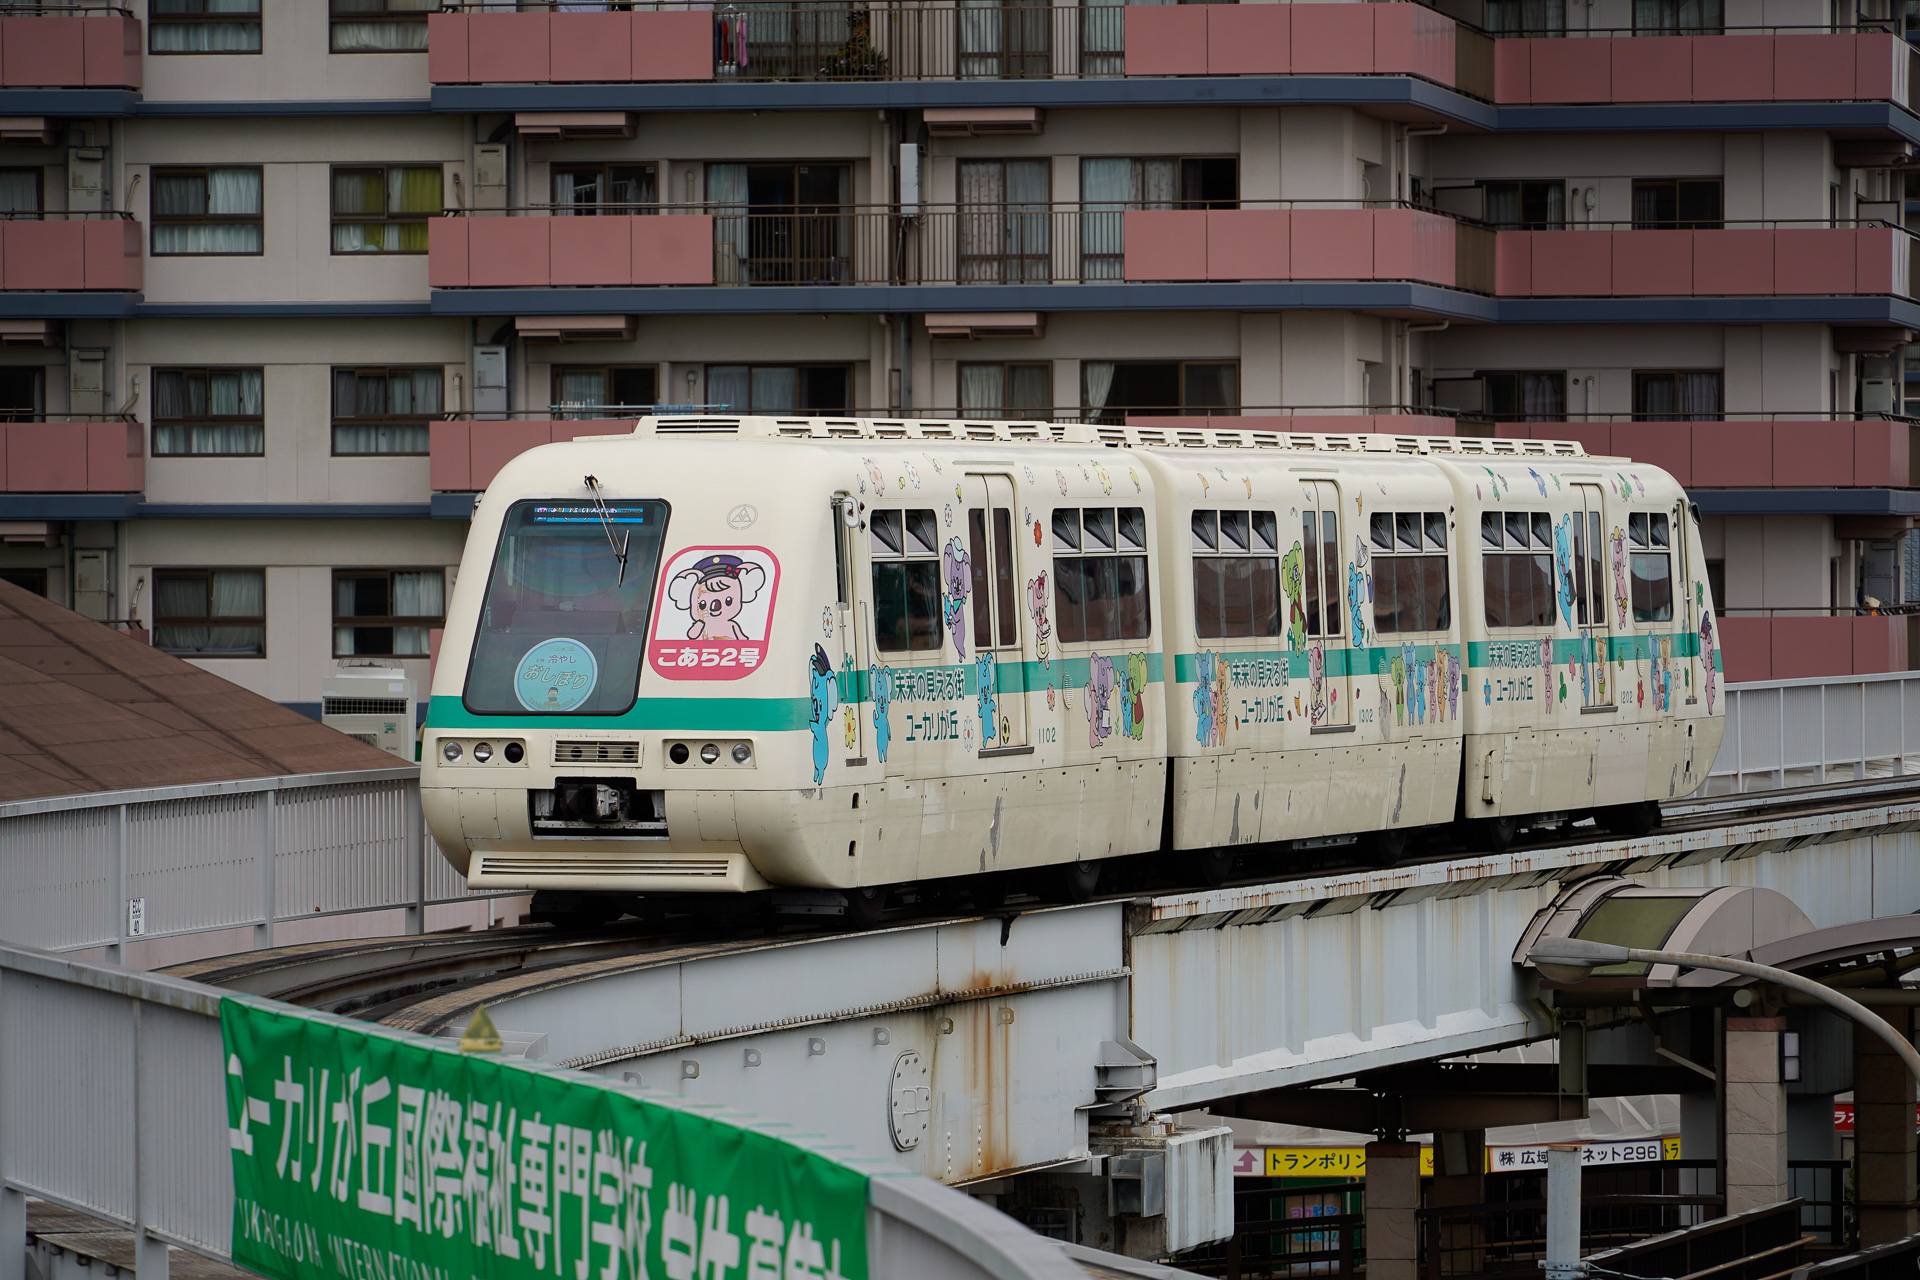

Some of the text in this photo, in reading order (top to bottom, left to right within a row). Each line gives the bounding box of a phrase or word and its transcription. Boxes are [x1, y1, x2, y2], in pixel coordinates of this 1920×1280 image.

[548, 654, 577, 664] 冷やし
[657, 646, 760, 668] こあら2号
[1489, 642, 1537, 670] 未来の見える街
[523, 664, 589, 690] おしぼり
[895, 668, 965, 703] 未来の見える街
[1232, 659, 1289, 690] 未来の見える街
[1496, 676, 1534, 702] ユーカリが丘
[1241, 695, 1285, 723] ユーカリが丘
[906, 709, 959, 742] ユーカリが丘
[1038, 726, 1056, 744] 1102
[1272, 1152, 1366, 1171] トランポリン
